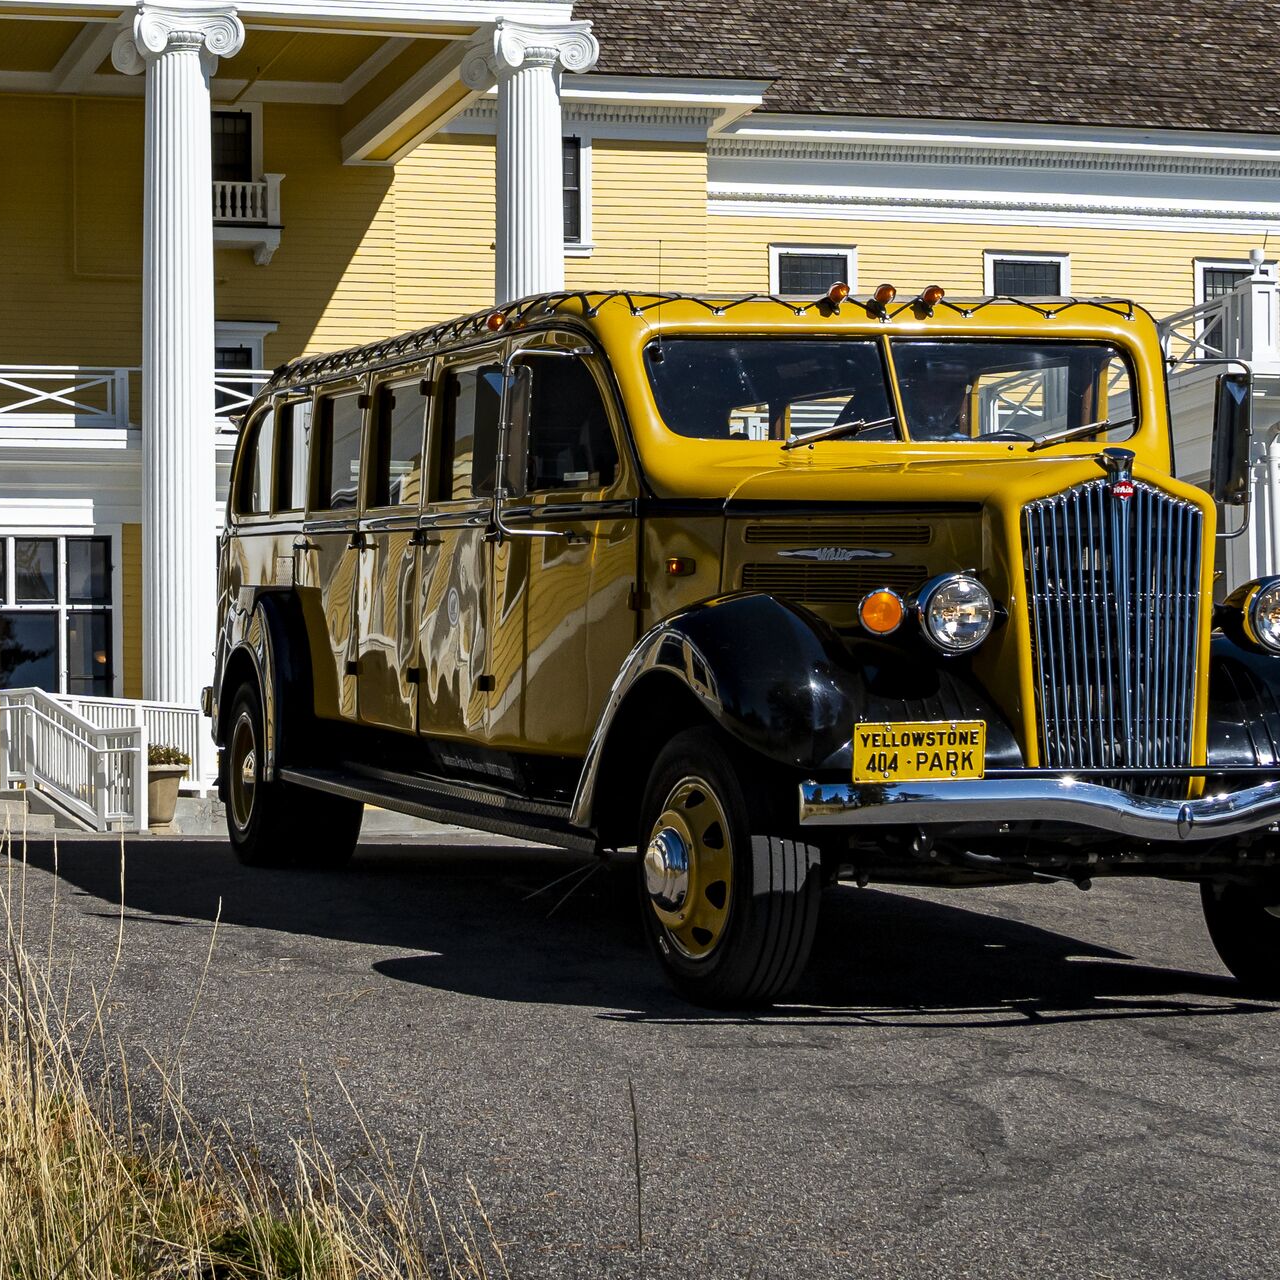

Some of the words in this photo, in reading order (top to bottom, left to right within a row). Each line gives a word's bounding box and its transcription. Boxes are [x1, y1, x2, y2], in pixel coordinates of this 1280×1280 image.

[860, 730, 979, 748] YELLOWSTONE
[866, 752, 898, 772] 404
[916, 750, 974, 771] PARK
